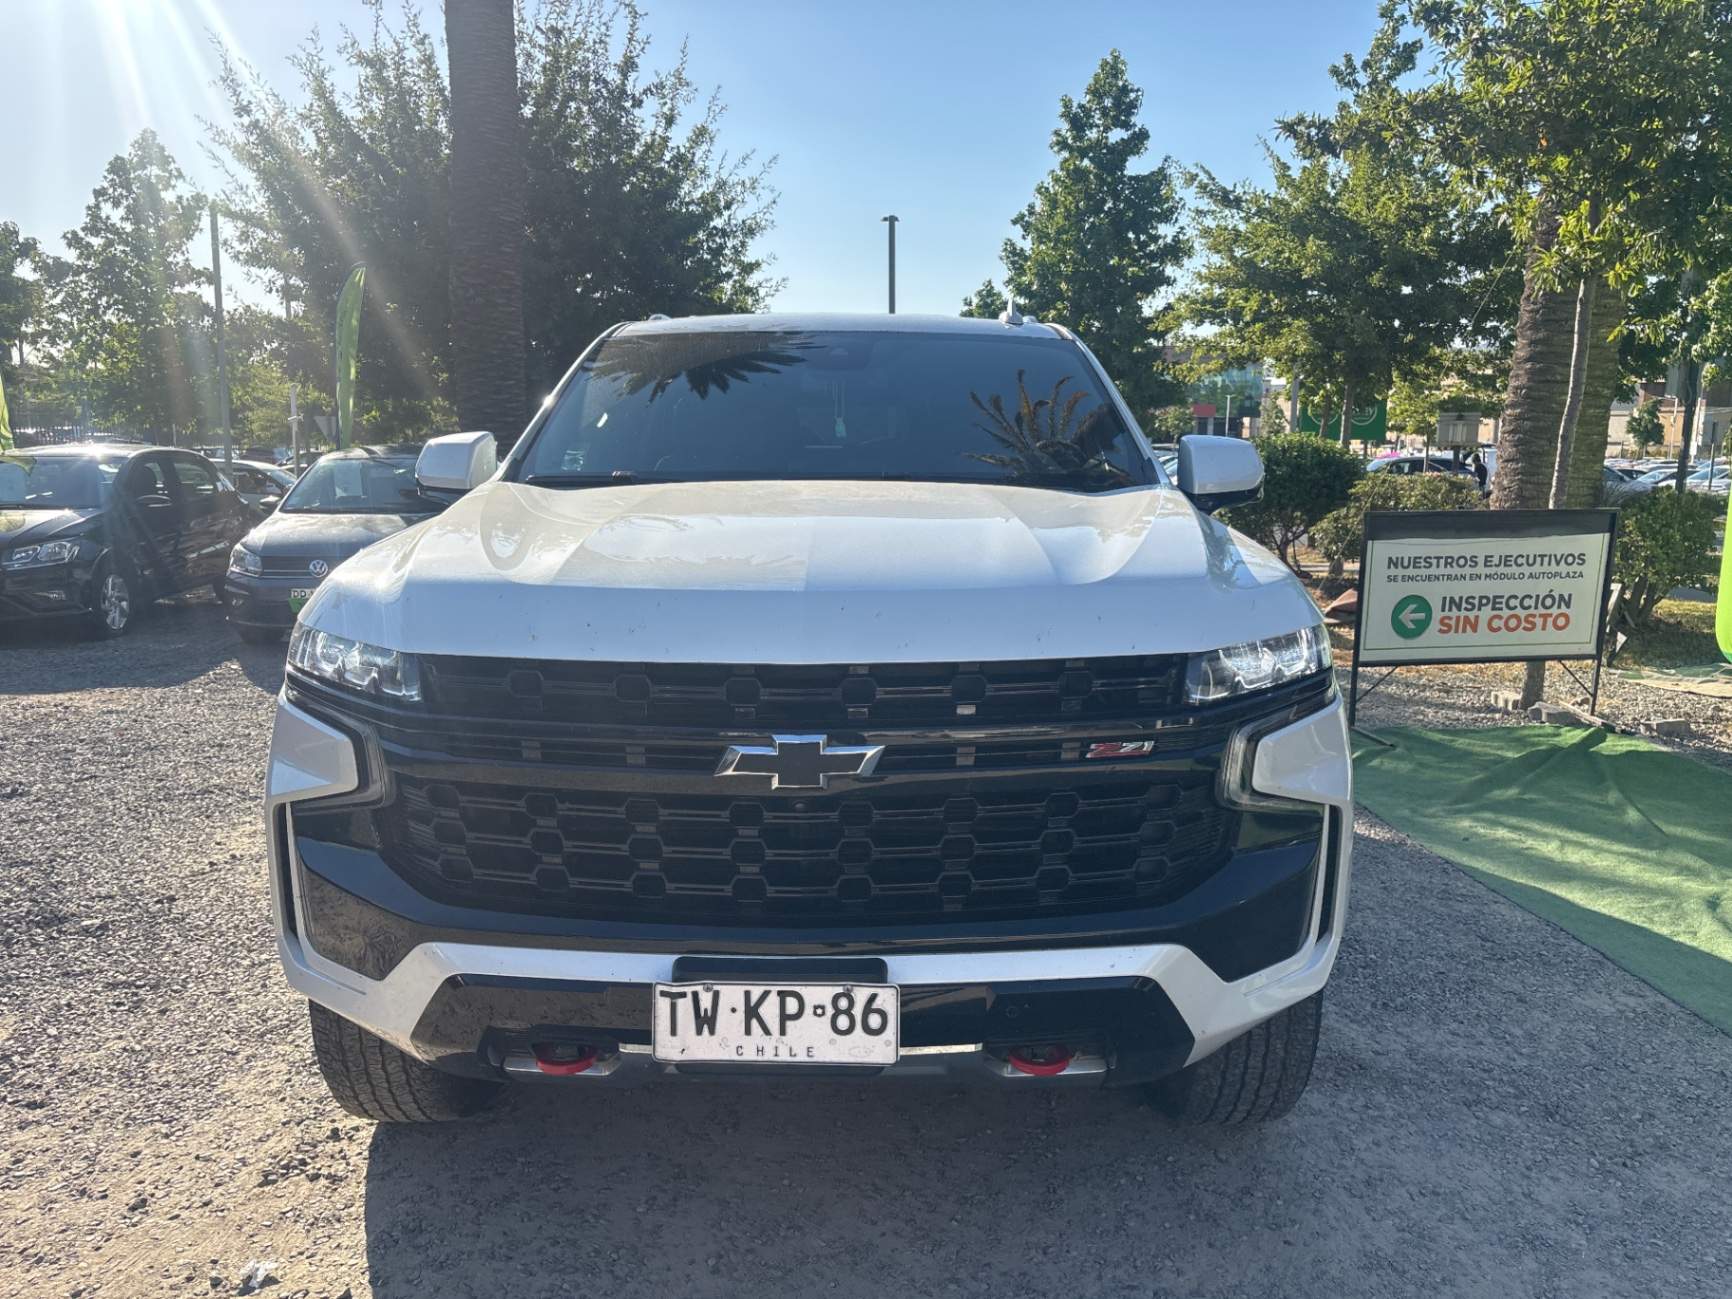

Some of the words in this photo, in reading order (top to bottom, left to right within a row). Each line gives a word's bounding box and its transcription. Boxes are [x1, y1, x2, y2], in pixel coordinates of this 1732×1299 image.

[1387, 555, 1478, 569] NUESTROS
[1483, 553, 1586, 567] EJECUTIVOS
[1387, 574, 1398, 583] SE
[1401, 573, 1466, 583] ENCUENTRAN
[1469, 573, 1482, 581] EN
[1484, 571, 1525, 581] MÓDULO
[1527, 571, 1584, 580] AUTOPLAZA
[1440, 589, 1572, 612] INSPECCIÓN
[1438, 614, 1479, 634] SIN
[1487, 612, 1570, 632] COSTO
[1085, 740, 1155, 758] Z71
[736, 1045, 816, 1057] CHILE
